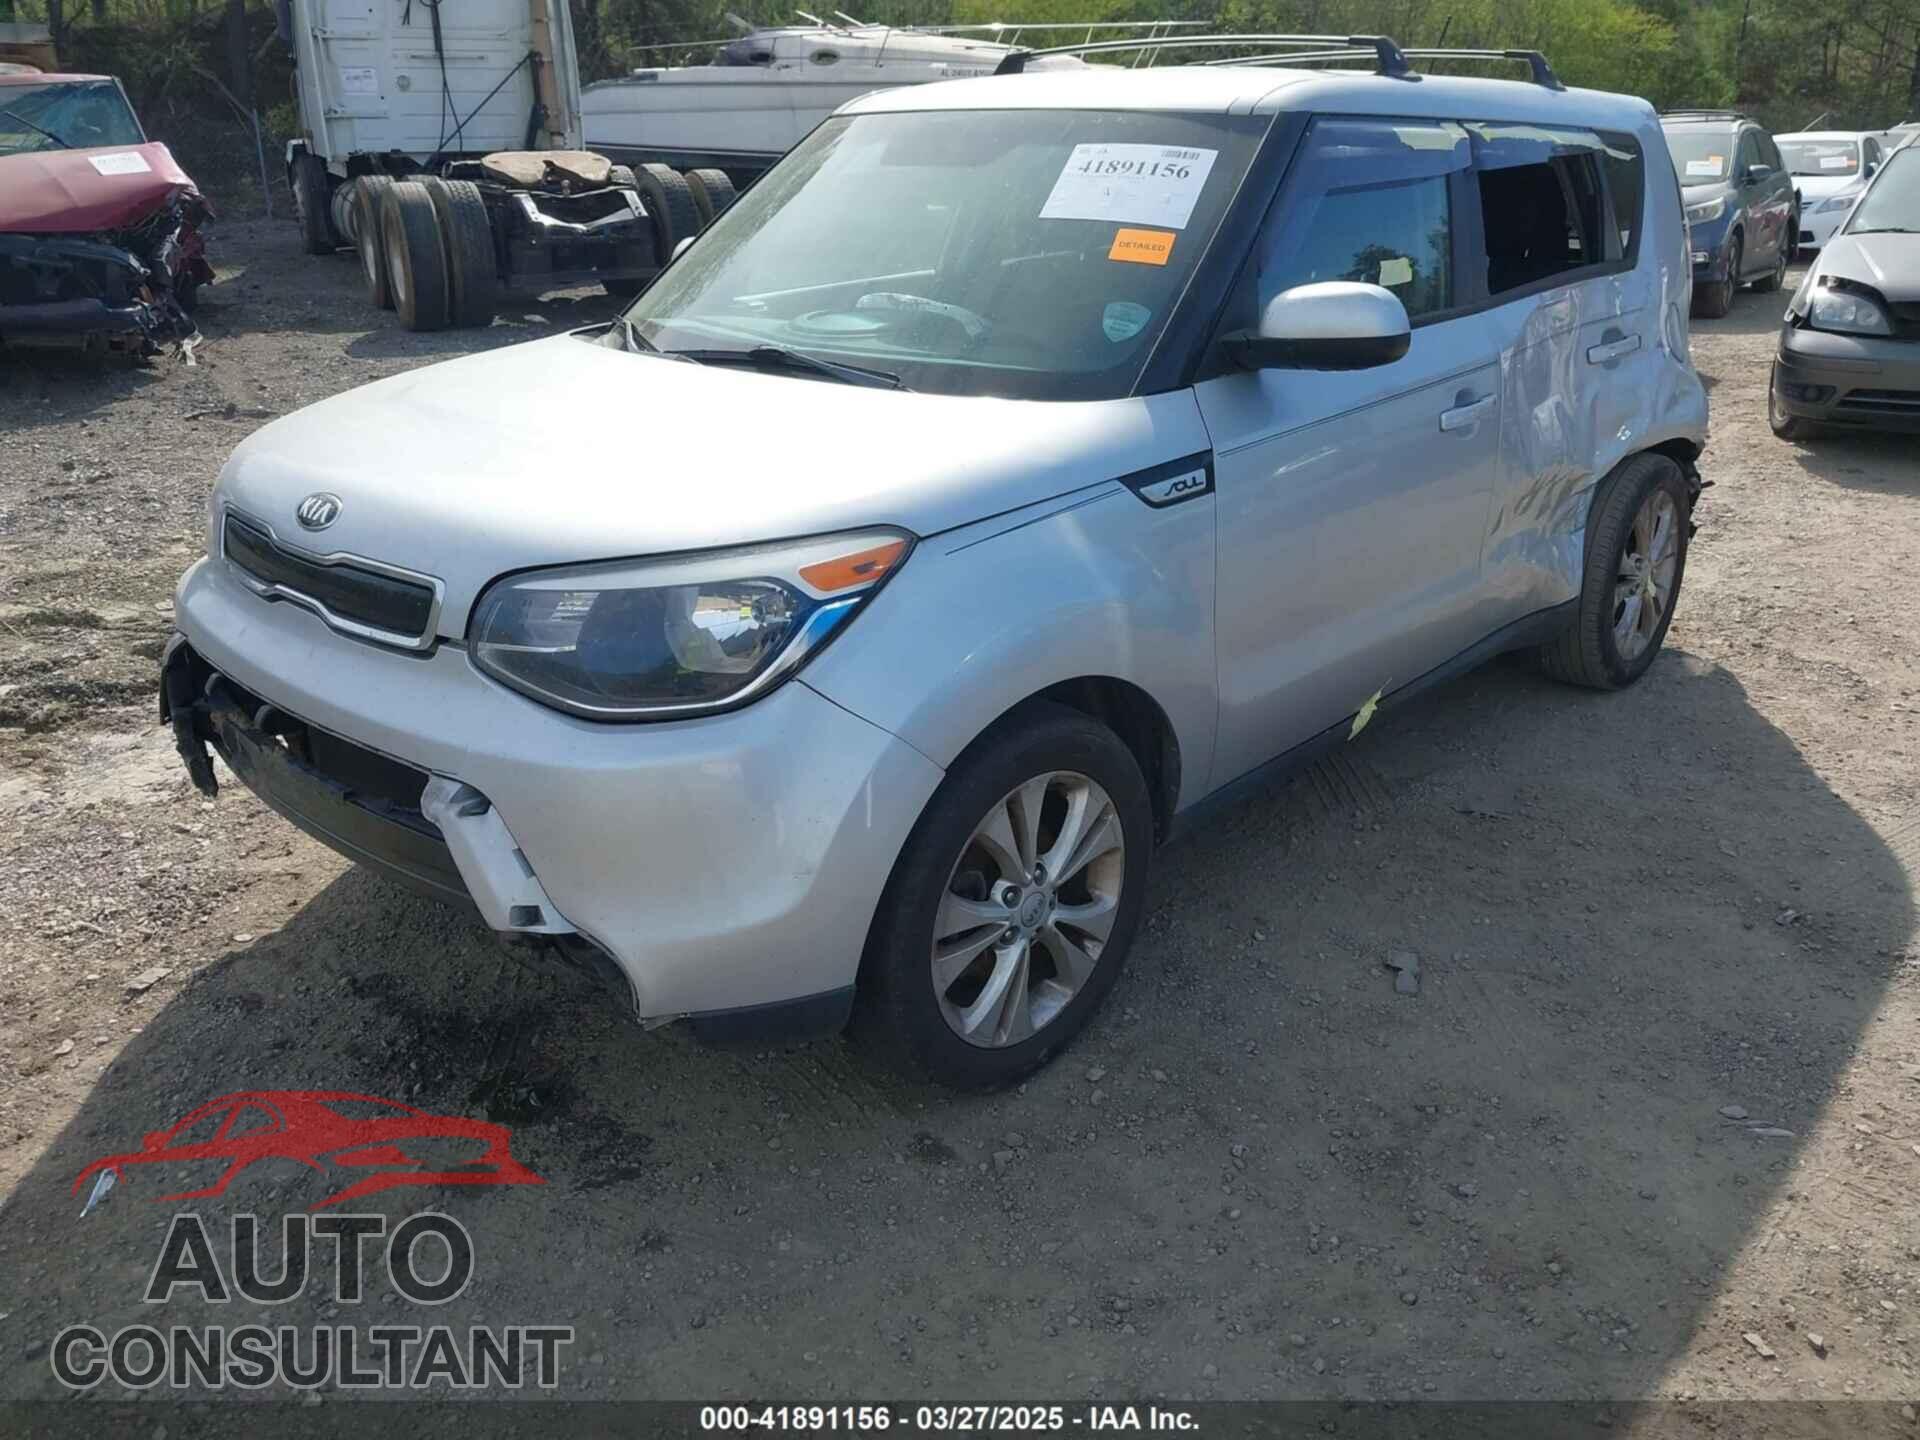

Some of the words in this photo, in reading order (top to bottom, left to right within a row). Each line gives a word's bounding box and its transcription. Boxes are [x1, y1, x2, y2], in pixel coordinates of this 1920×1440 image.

[1078, 159, 1192, 180] 41891156
[1117, 240, 1166, 252] DETAILED
[300, 496, 334, 525] KIA
